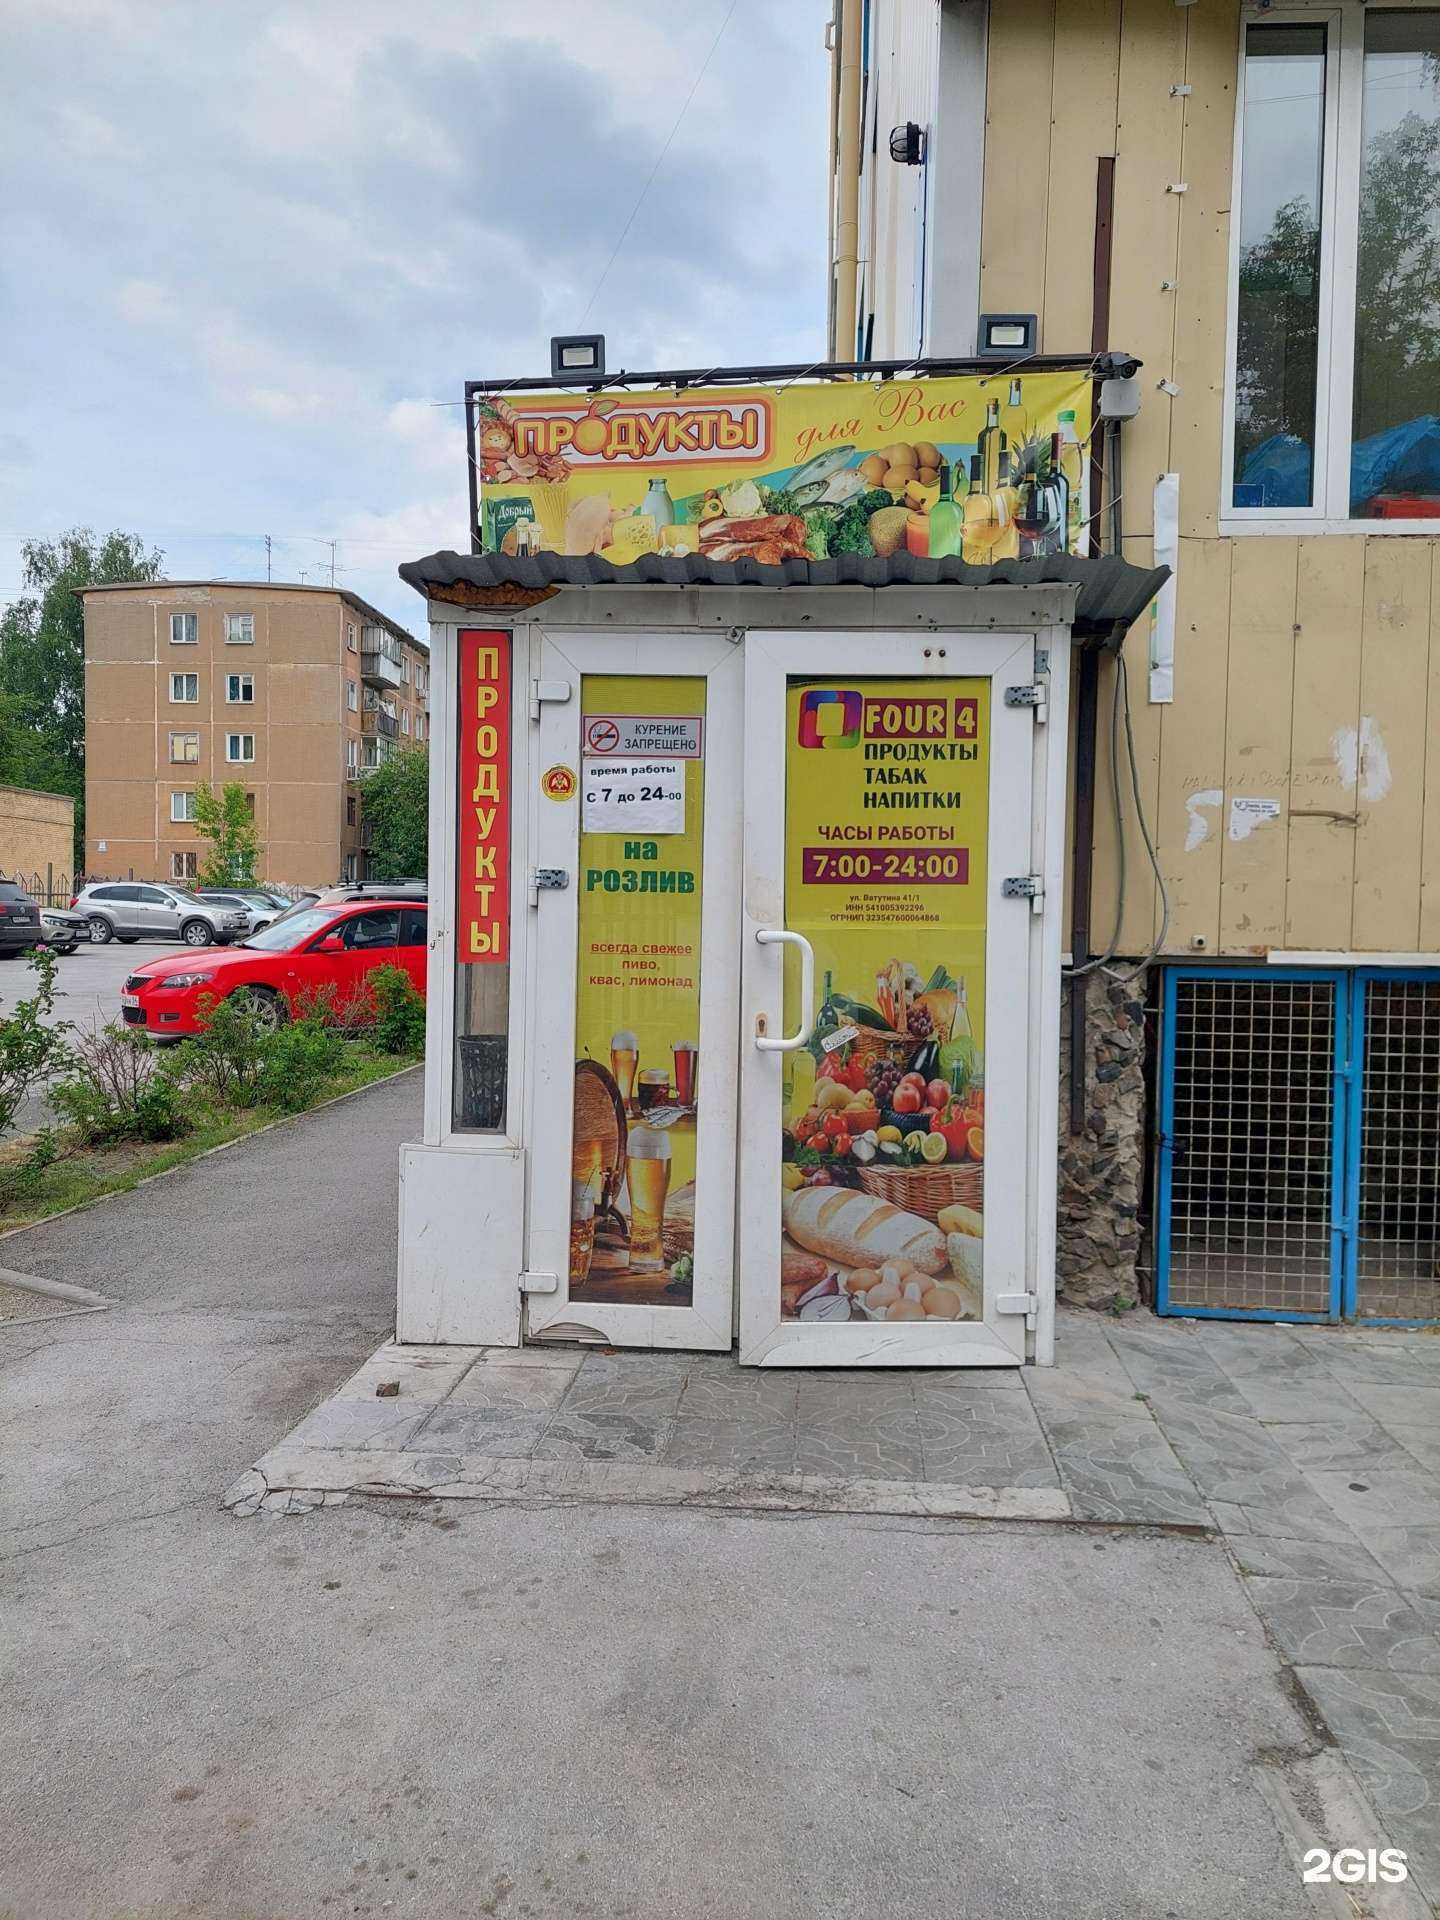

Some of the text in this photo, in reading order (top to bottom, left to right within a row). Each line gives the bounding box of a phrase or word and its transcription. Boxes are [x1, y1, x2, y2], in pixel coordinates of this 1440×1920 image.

[794, 385, 967, 464] для Вас
[513, 408, 758, 460] ПРОДУКТЫ
[865, 704, 976, 734] FOUR 4
[635, 724, 687, 736] КУРЕНИЕ
[624, 738, 697, 751] ЗАПРЕЩЕНО
[863, 743, 978, 762] ПРОДУКТЫ
[590, 765, 676, 778] время работы
[863, 767, 928, 785] ТАБАК
[470, 647, 500, 953] ПРОДУКТЫ
[601, 788, 613, 802] 7
[617, 793, 636, 804] до
[863, 791, 961, 809] НАПИТКИ
[817, 825, 955, 841] ЧАСЫ РАБОТЫ
[623, 841, 659, 860] на
[812, 854, 960, 878] 7:00-24:00
[586, 869, 695, 893] РОЗЛИВ
[863, 894, 901, 903] Ватутина
[902, 894, 920, 902] 41/1
[845, 903, 925, 912] ИНН 541005392296
[830, 914, 865, 922] ОГРНИП
[591, 943, 692, 955] всегда свежее
[622, 960, 660, 971] пиво,
[589, 976, 693, 988] квас, лимонад
